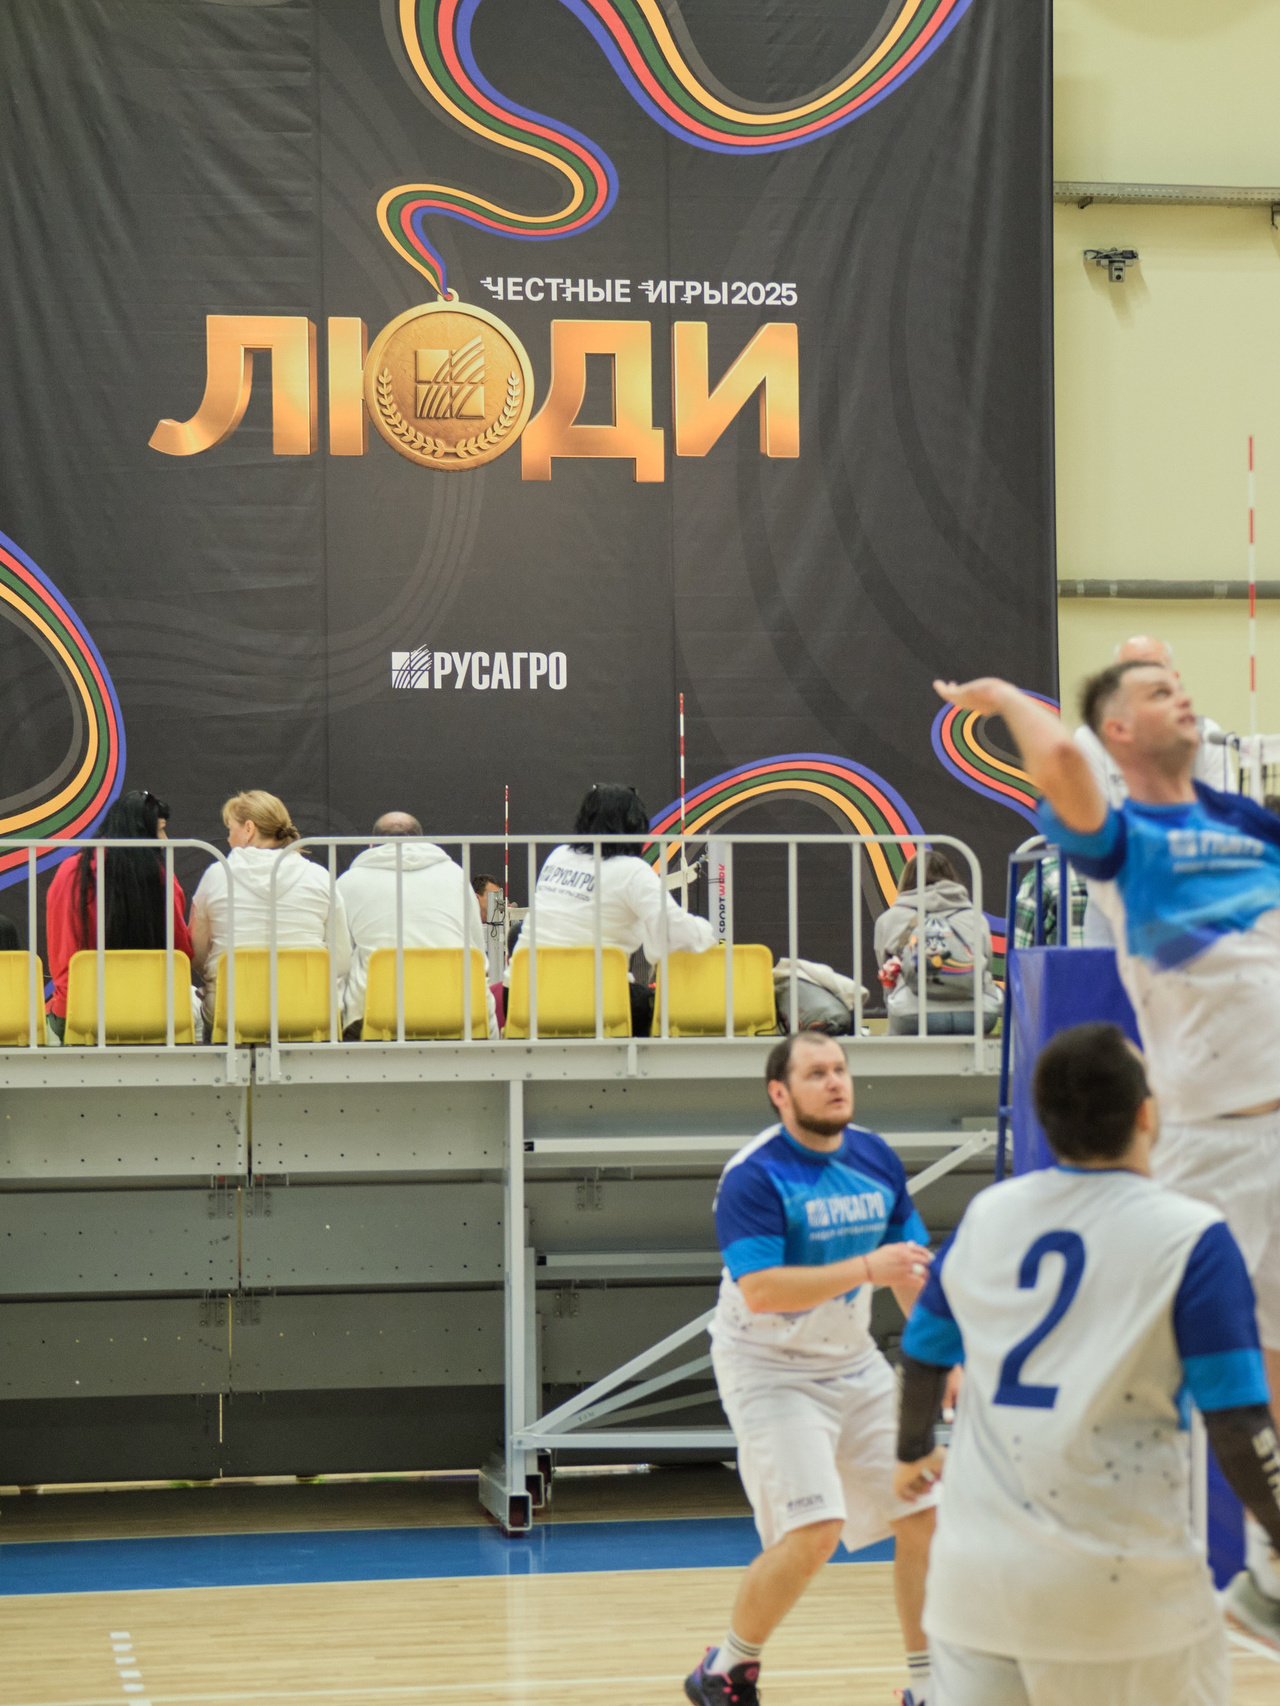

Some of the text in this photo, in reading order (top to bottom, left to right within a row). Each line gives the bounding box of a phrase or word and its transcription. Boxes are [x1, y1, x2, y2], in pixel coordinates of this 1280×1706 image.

[480, 276, 632, 303] ЧЕСТНЫЕ
[148, 301, 800, 483] ЛЮДИ
[433, 651, 568, 690] РУСАГРО
[992, 1229, 1087, 1410] 2
